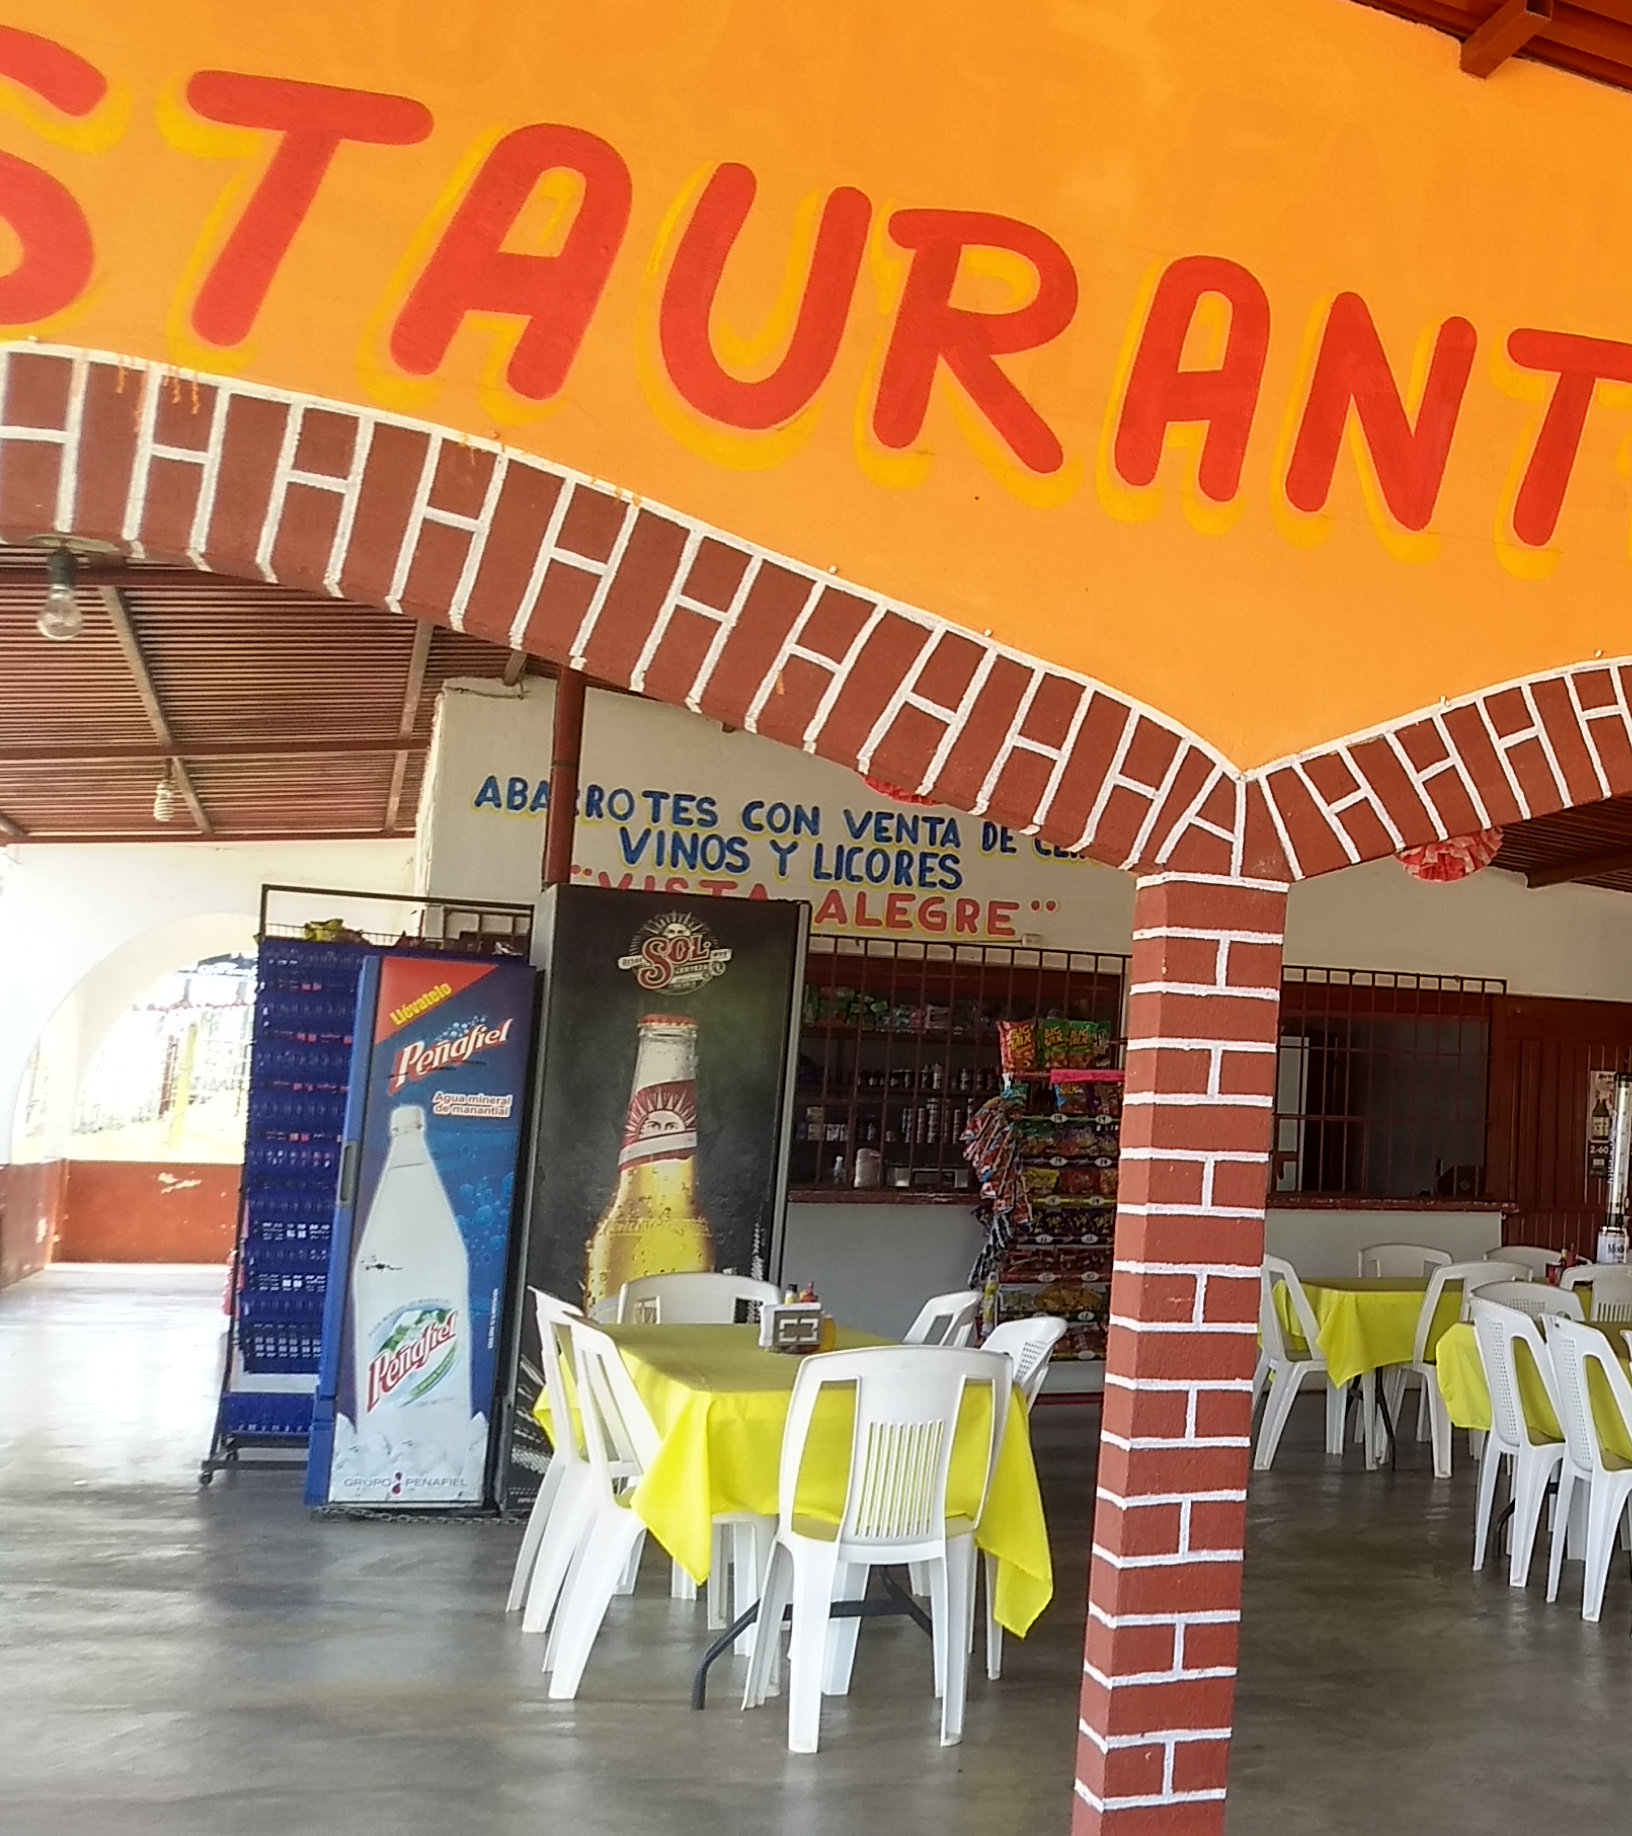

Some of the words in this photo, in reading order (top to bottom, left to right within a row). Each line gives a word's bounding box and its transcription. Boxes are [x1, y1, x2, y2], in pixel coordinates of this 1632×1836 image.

[474, 775, 718, 828] ABAROTES
[741, 800, 820, 837] CON
[843, 808, 962, 850] VENTA
[982, 820, 1017, 854] DE
[618, 825, 750, 874] VINOS
[768, 838, 799, 877] Y
[812, 841, 964, 890] LICORES
[389, 982, 452, 1027] Llévatelo
[391, 1017, 514, 1092] Peñafiel
[434, 1093, 465, 1105] Agua
[467, 1094, 511, 1105] mineral
[435, 1104, 448, 1114] de
[343, 1478, 391, 1488] GRUPO
